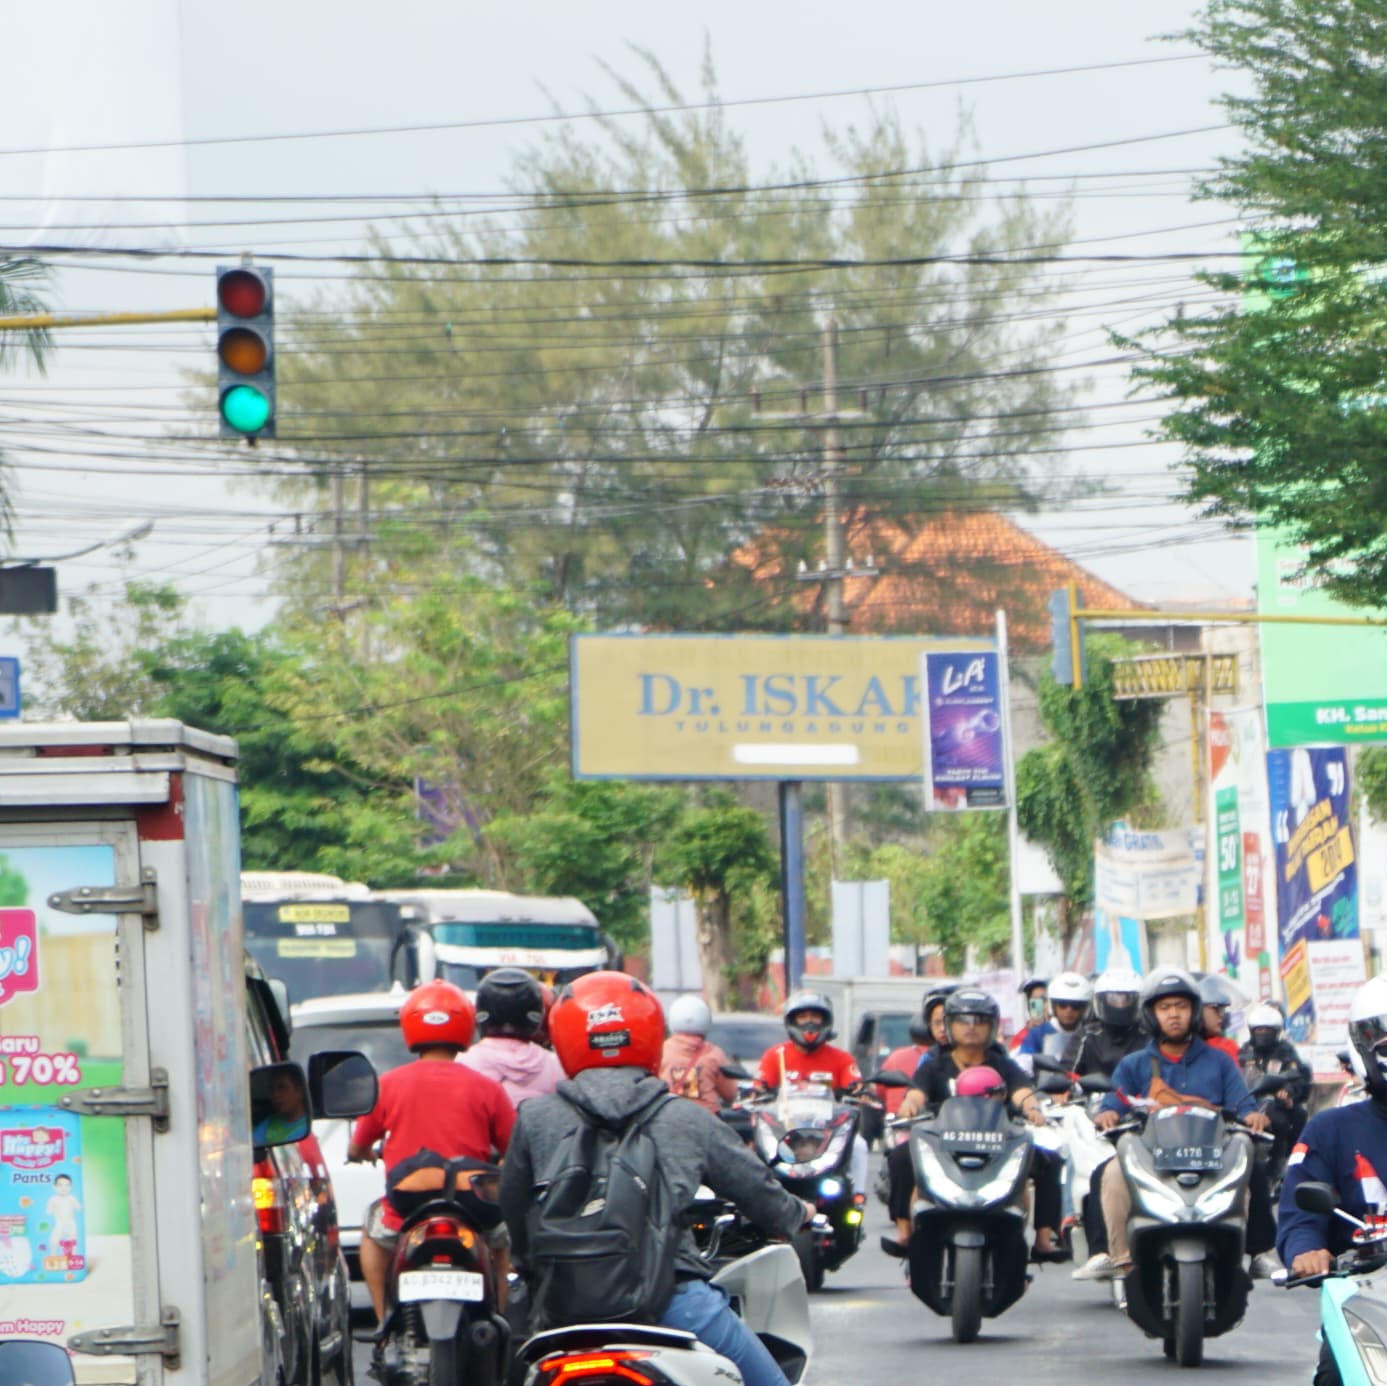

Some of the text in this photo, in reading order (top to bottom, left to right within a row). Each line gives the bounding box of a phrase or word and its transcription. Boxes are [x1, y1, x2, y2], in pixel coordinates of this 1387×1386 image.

[636, 673, 721, 716] Dr.
[1315, 706, 1351, 725] KH.
[675, 721, 910, 733] TULUNGAGUNG
[11, 1056, 80, 1085] 70%
[12, 1173, 52, 1184] Pants
[17, 1320, 65, 1335] Happy
